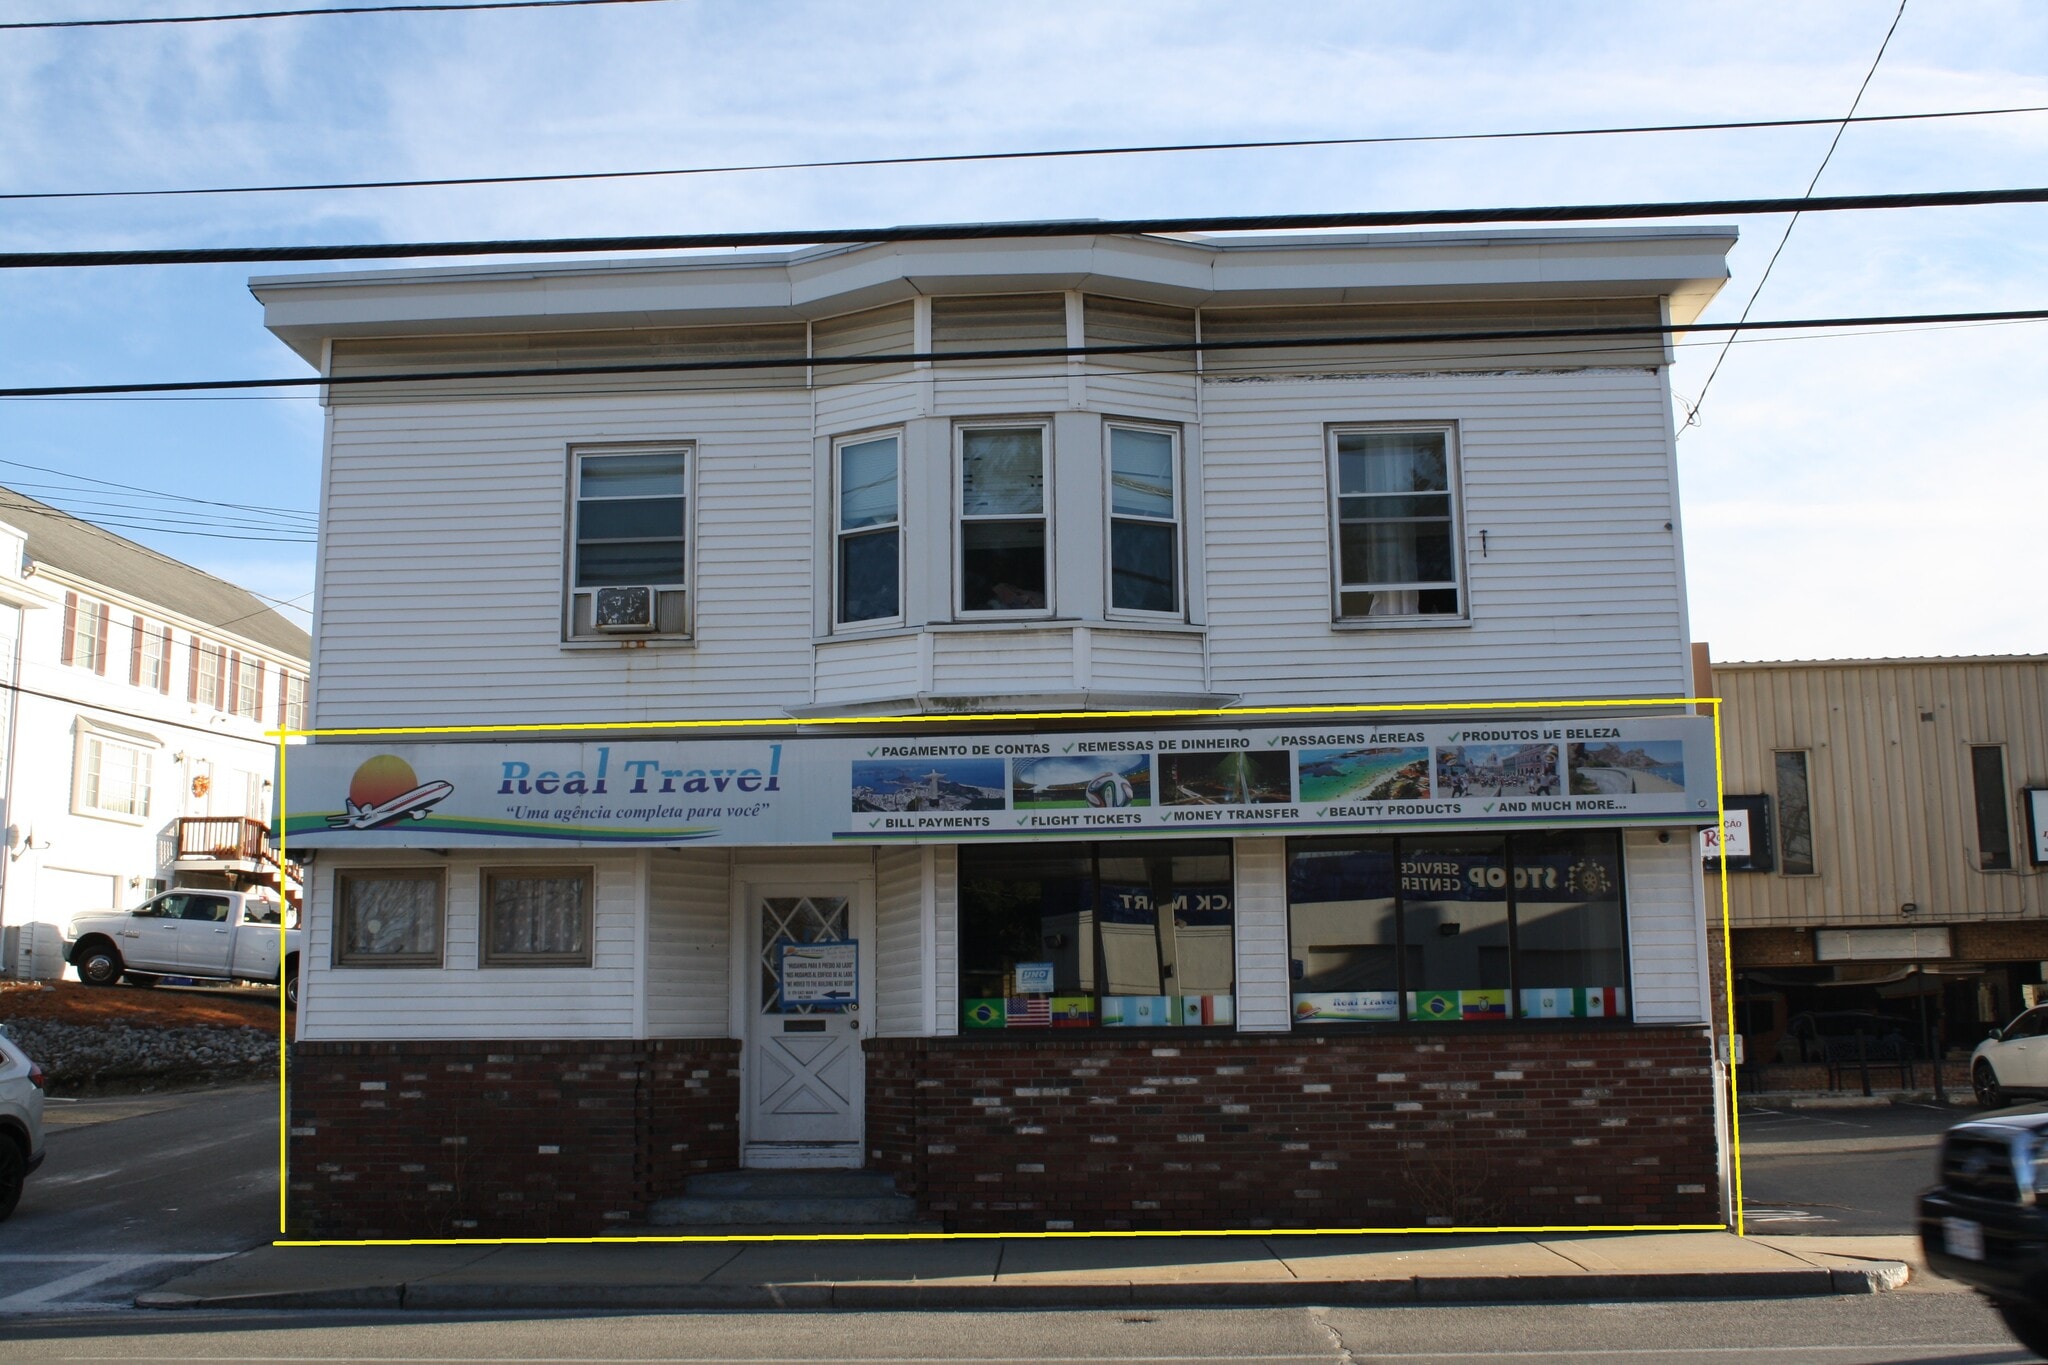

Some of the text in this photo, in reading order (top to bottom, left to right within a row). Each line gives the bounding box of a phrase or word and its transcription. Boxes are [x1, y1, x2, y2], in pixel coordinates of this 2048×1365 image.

[1281, 732, 1425, 746] PASSAGENS AEREAS
[1462, 728, 1621, 742] PRODUTOS DE BELEZA
[881, 743, 1050, 757] PAGAMENTO DE CONTAS
[1078, 738, 1250, 752] REMESSAS DE DINHEIRO
[497, 744, 782, 795] Real Travel
[553, 803, 611, 822] agência
[616, 803, 683, 822] completa
[686, 807, 722, 821] para
[1329, 803, 1462, 817] BEAUTY PRODUCTS
[1498, 799, 1627, 812] AND MUCH MORE...
[1031, 813, 1142, 826] FLIGHT TICKETS
[1173, 808, 1300, 821] MONEY TRANSFER
[885, 816, 990, 828] BILL PAYMENTS
